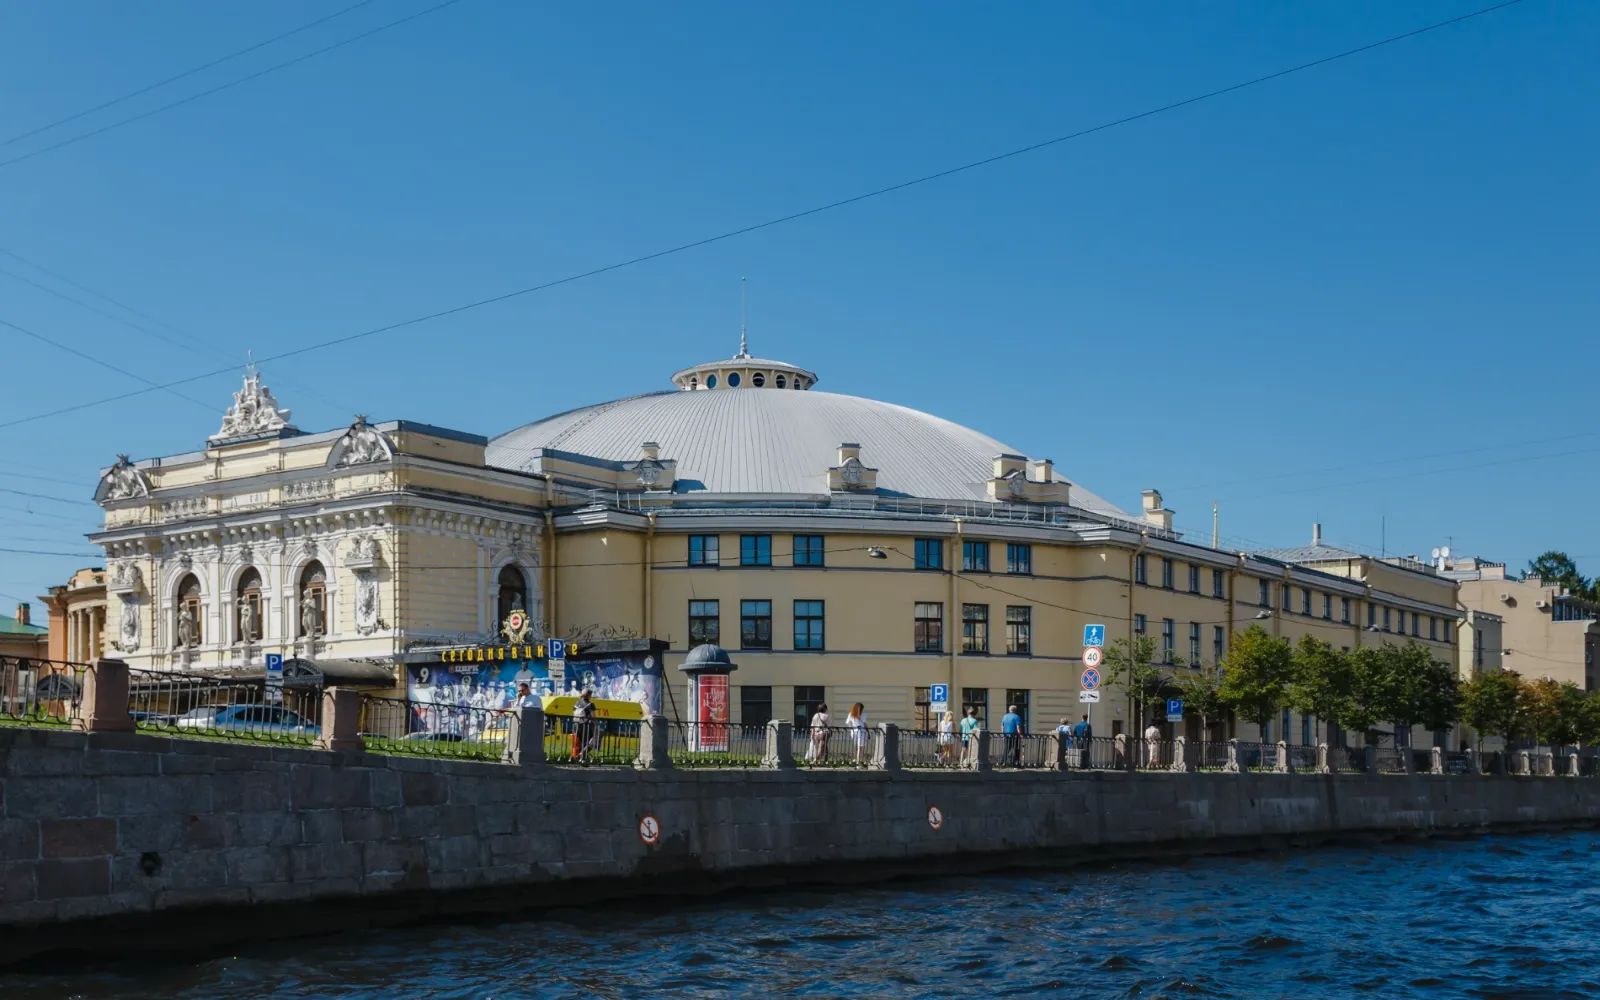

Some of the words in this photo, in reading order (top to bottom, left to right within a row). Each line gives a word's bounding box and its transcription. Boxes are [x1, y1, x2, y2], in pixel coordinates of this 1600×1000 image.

[441, 646, 505, 662] сегодня
[511, 646, 518, 659] в
[525, 643, 578, 659] цие
[553, 641, 562, 657] P
[270, 655, 279, 669] P
[1087, 653, 1098, 662] 40
[420, 667, 429, 683] 9
[934, 686, 944, 700] P
[1170, 701, 1180, 712] P
